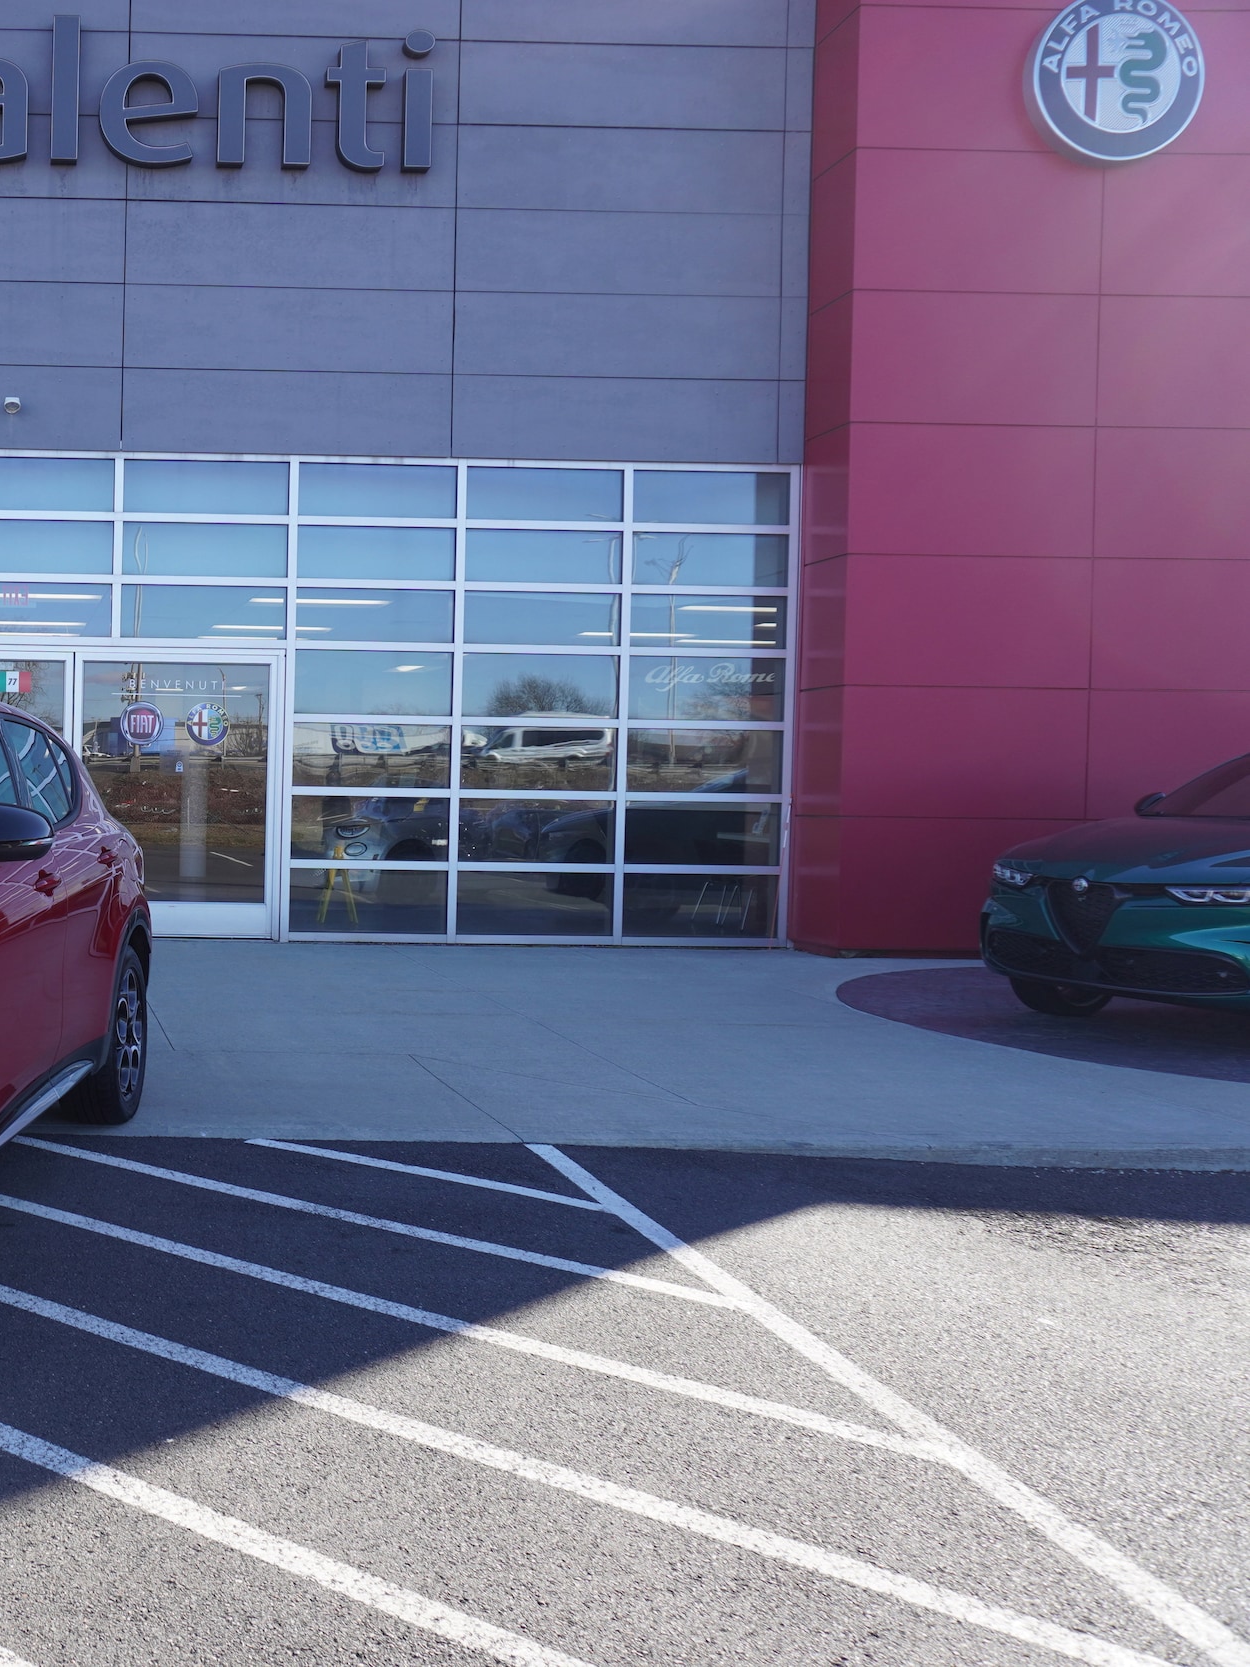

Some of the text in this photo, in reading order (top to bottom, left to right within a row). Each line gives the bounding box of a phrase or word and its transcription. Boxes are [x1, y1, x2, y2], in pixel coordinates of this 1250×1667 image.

[1041, 0, 1199, 78] ALFA ROMEO
[7, 677, 18, 686] 77
[129, 679, 225, 691] BENVENUTI
[645, 662, 775, 692] Alfa Rome
[130, 714, 154, 734] FIAT
[206, 703, 229, 727] ROMEO
